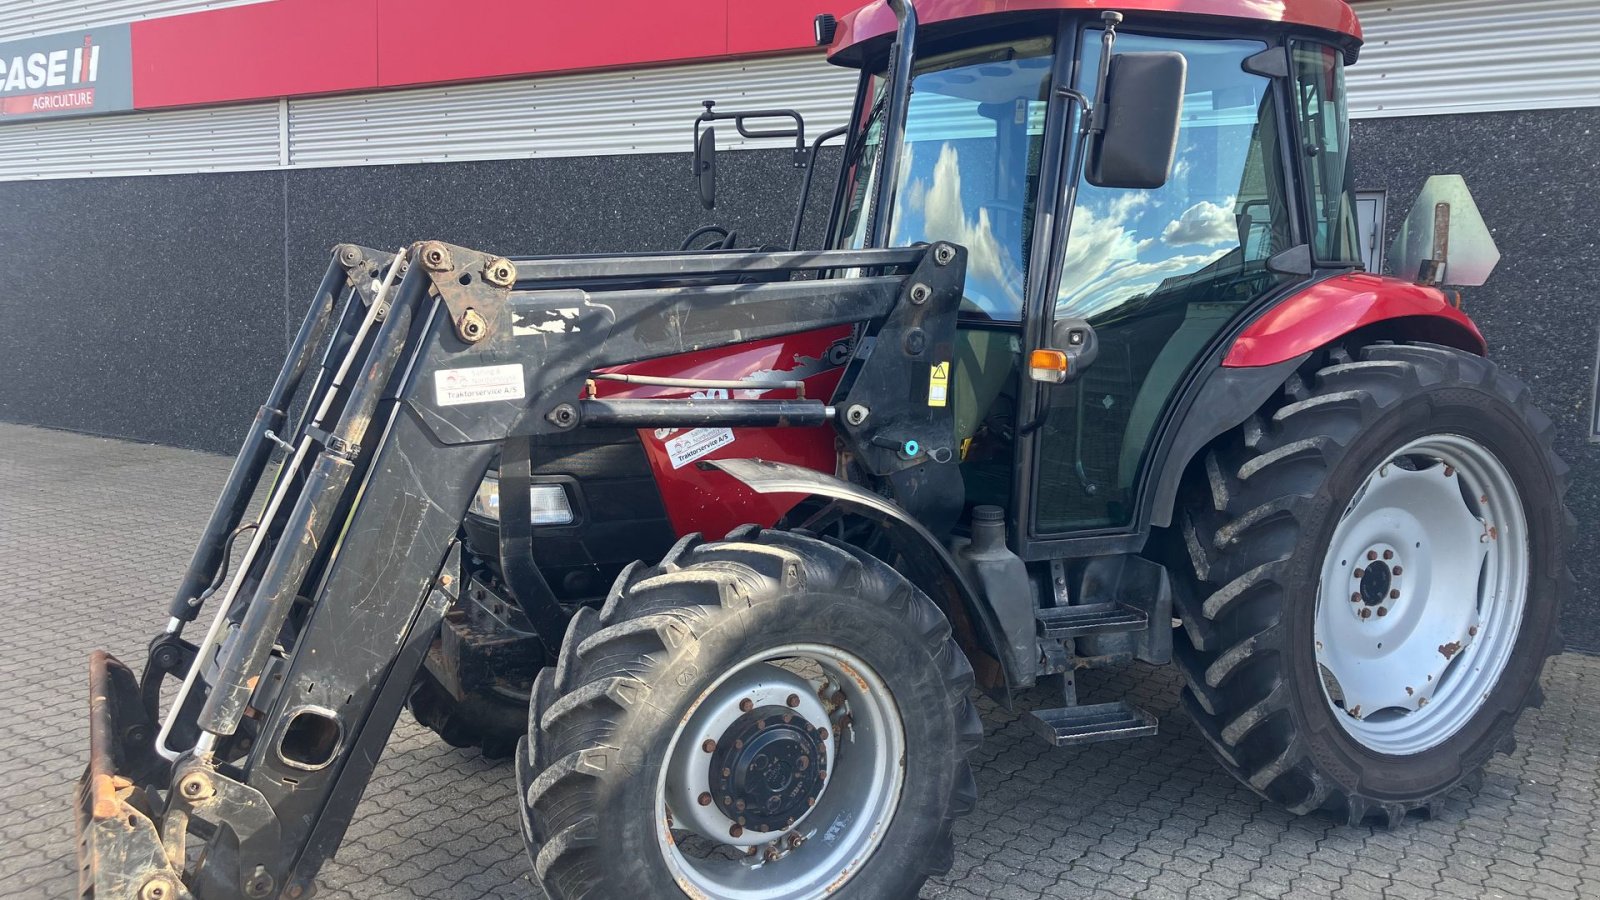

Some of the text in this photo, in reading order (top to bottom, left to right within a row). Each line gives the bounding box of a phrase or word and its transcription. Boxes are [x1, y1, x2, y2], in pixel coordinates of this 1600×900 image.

[32, 92, 92, 110] AGRICULTURE
[448, 387, 502, 399] Traktorservice
[504, 386, 518, 394] A/S
[678, 439, 718, 462] Traktorservice
[718, 433, 729, 443] A/S
